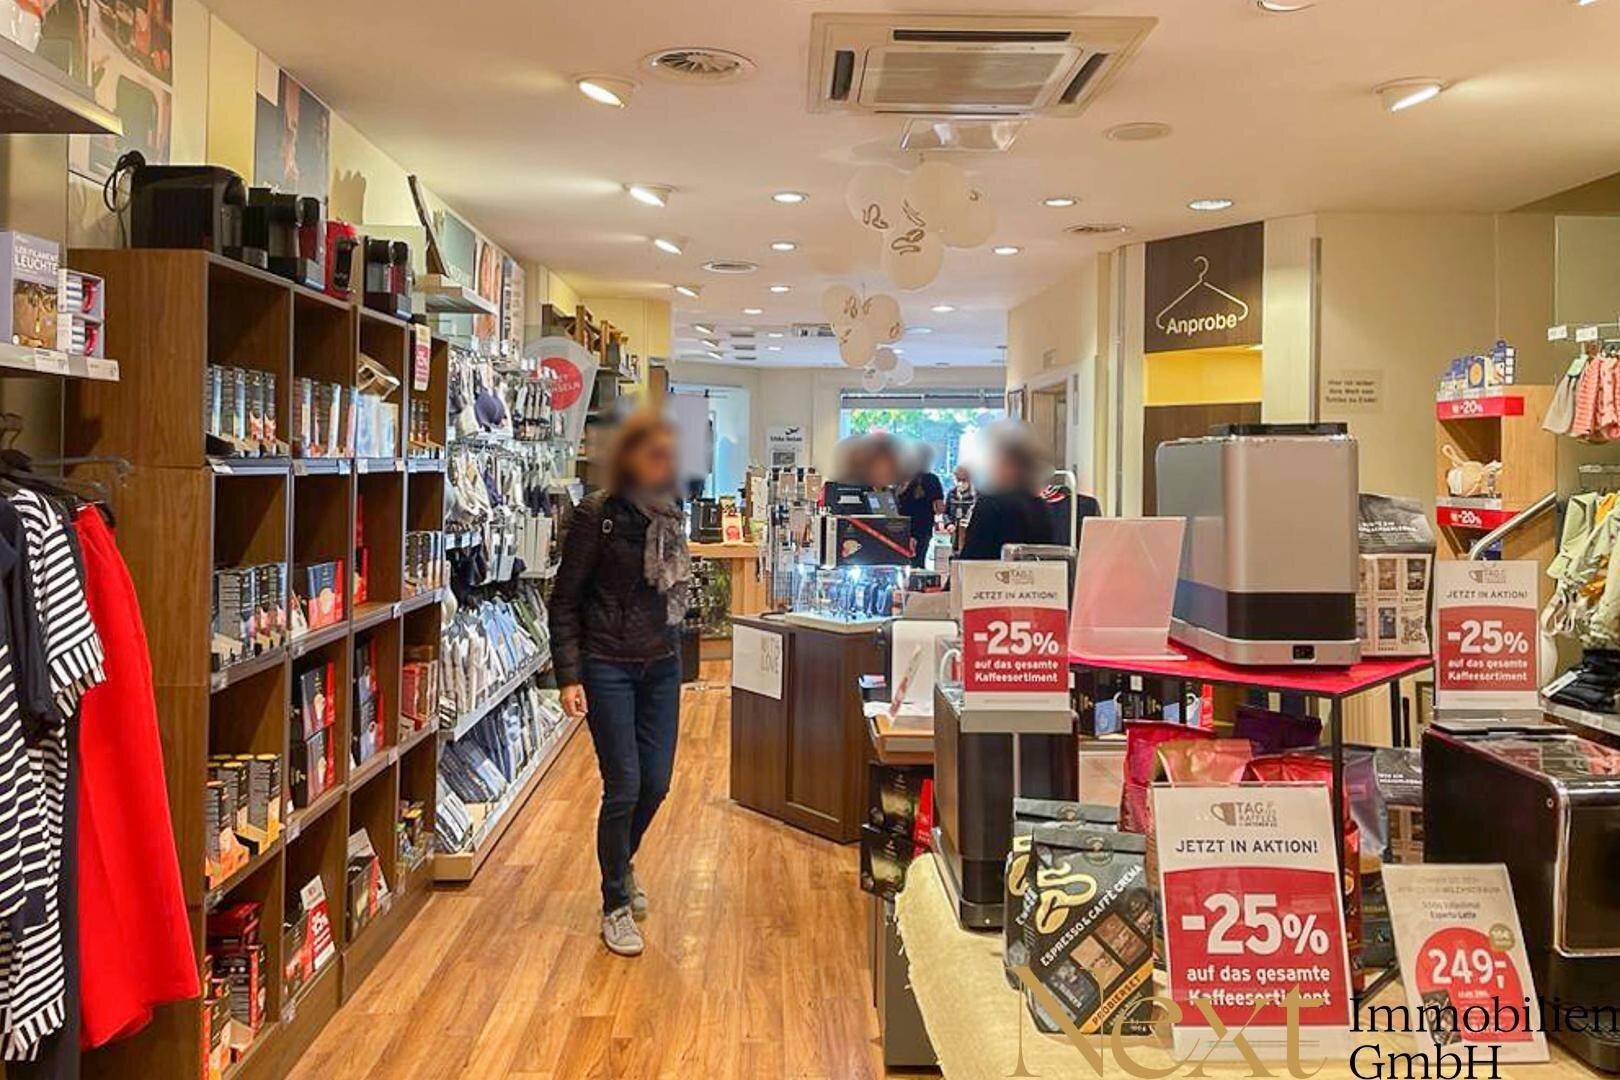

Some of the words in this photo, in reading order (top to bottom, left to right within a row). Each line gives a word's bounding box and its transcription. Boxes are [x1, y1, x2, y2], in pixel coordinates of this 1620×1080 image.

[14, 254, 58, 275] LEUCHTE
[1166, 313, 1238, 336] Anprobe
[973, 591, 1002, 600] JETZT
[1005, 591, 1016, 600] IN
[1018, 591, 1058, 600] AKTION!
[1447, 590, 1476, 599] JETZT
[1478, 590, 1489, 599] IN
[1490, 590, 1528, 599] AKTION!
[973, 620, 1060, 656] -25%
[1447, 619, 1529, 655] -25%
[974, 660, 992, 670] auf
[993, 660, 1013, 670] das
[1014, 660, 1059, 672] gesamte
[1448, 658, 1464, 669] auf
[1465, 658, 1485, 669] das
[1486, 658, 1528, 670] gesamte
[974, 672, 1058, 683] Kaffeesortiment
[1448, 671, 1528, 681] Kaffeesortiment
[1236, 801, 1264, 815] TAG
[1176, 839, 1225, 853] JETZT
[1230, 839, 1247, 853] IN
[1252, 839, 1318, 853] AKTION!
[1041, 921, 1085, 966] ESPRESSO
[1113, 864, 1143, 893] CREMA
[1181, 892, 1330, 955] -25%
[1187, 964, 1216, 982] auf
[1219, 964, 1252, 982] das
[1256, 964, 1331, 985] gesamte
